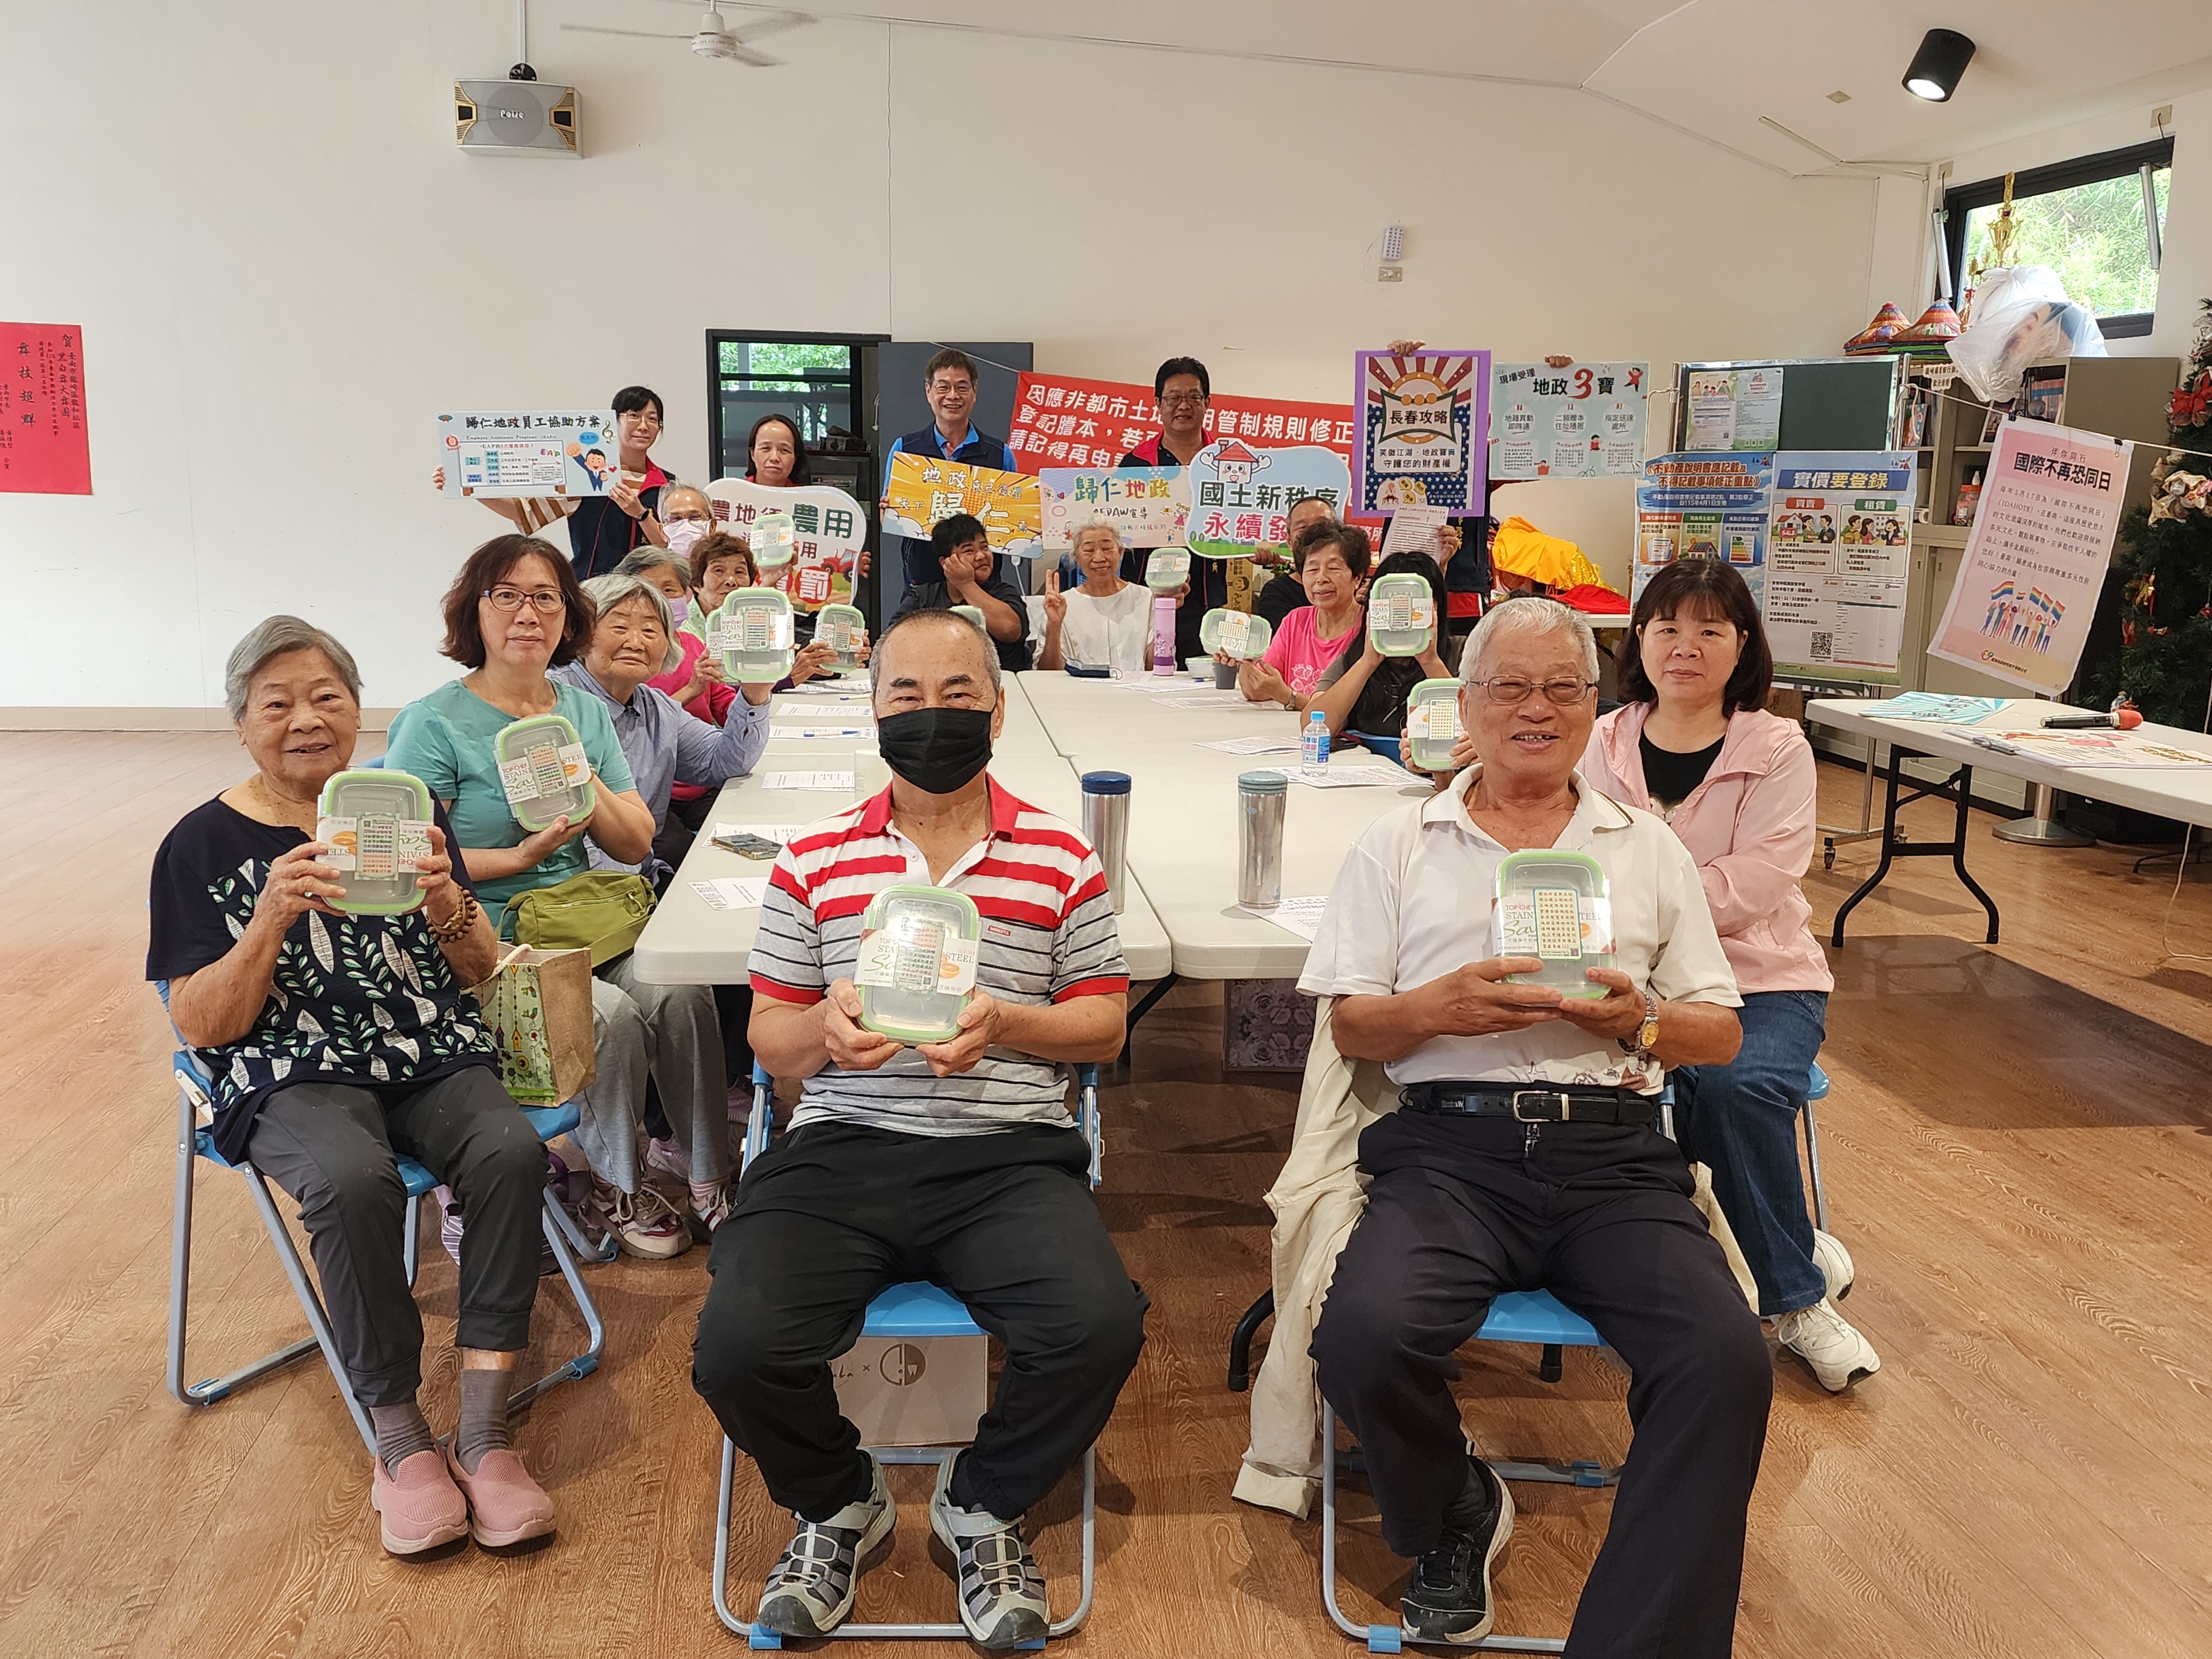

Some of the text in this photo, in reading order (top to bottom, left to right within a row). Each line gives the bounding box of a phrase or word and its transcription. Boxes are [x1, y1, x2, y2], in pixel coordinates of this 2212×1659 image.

[62, 333, 72, 348] 賀
[1499, 368, 1536, 384] 現場受理
[1533, 368, 1615, 399] 地政3寶
[17, 342, 35, 427] 舞技超群
[466, 415, 601, 429] 歸仁地政員工協助方案
[1390, 410, 1448, 425] 長春攻略
[540, 448, 561, 457] EAP
[2051, 447, 2087, 463] 伴你同行
[922, 466, 967, 489] 地政
[2013, 452, 2111, 492] 國際不再恐同日
[1793, 472, 1888, 489] 實價要登錄
[1074, 476, 1171, 504] 歸仁地政
[899, 499, 924, 511] 天下
[1796, 499, 1815, 508] 買賣
[1864, 500, 1886, 510] 租賃
[945, 952, 974, 964] STEEL
